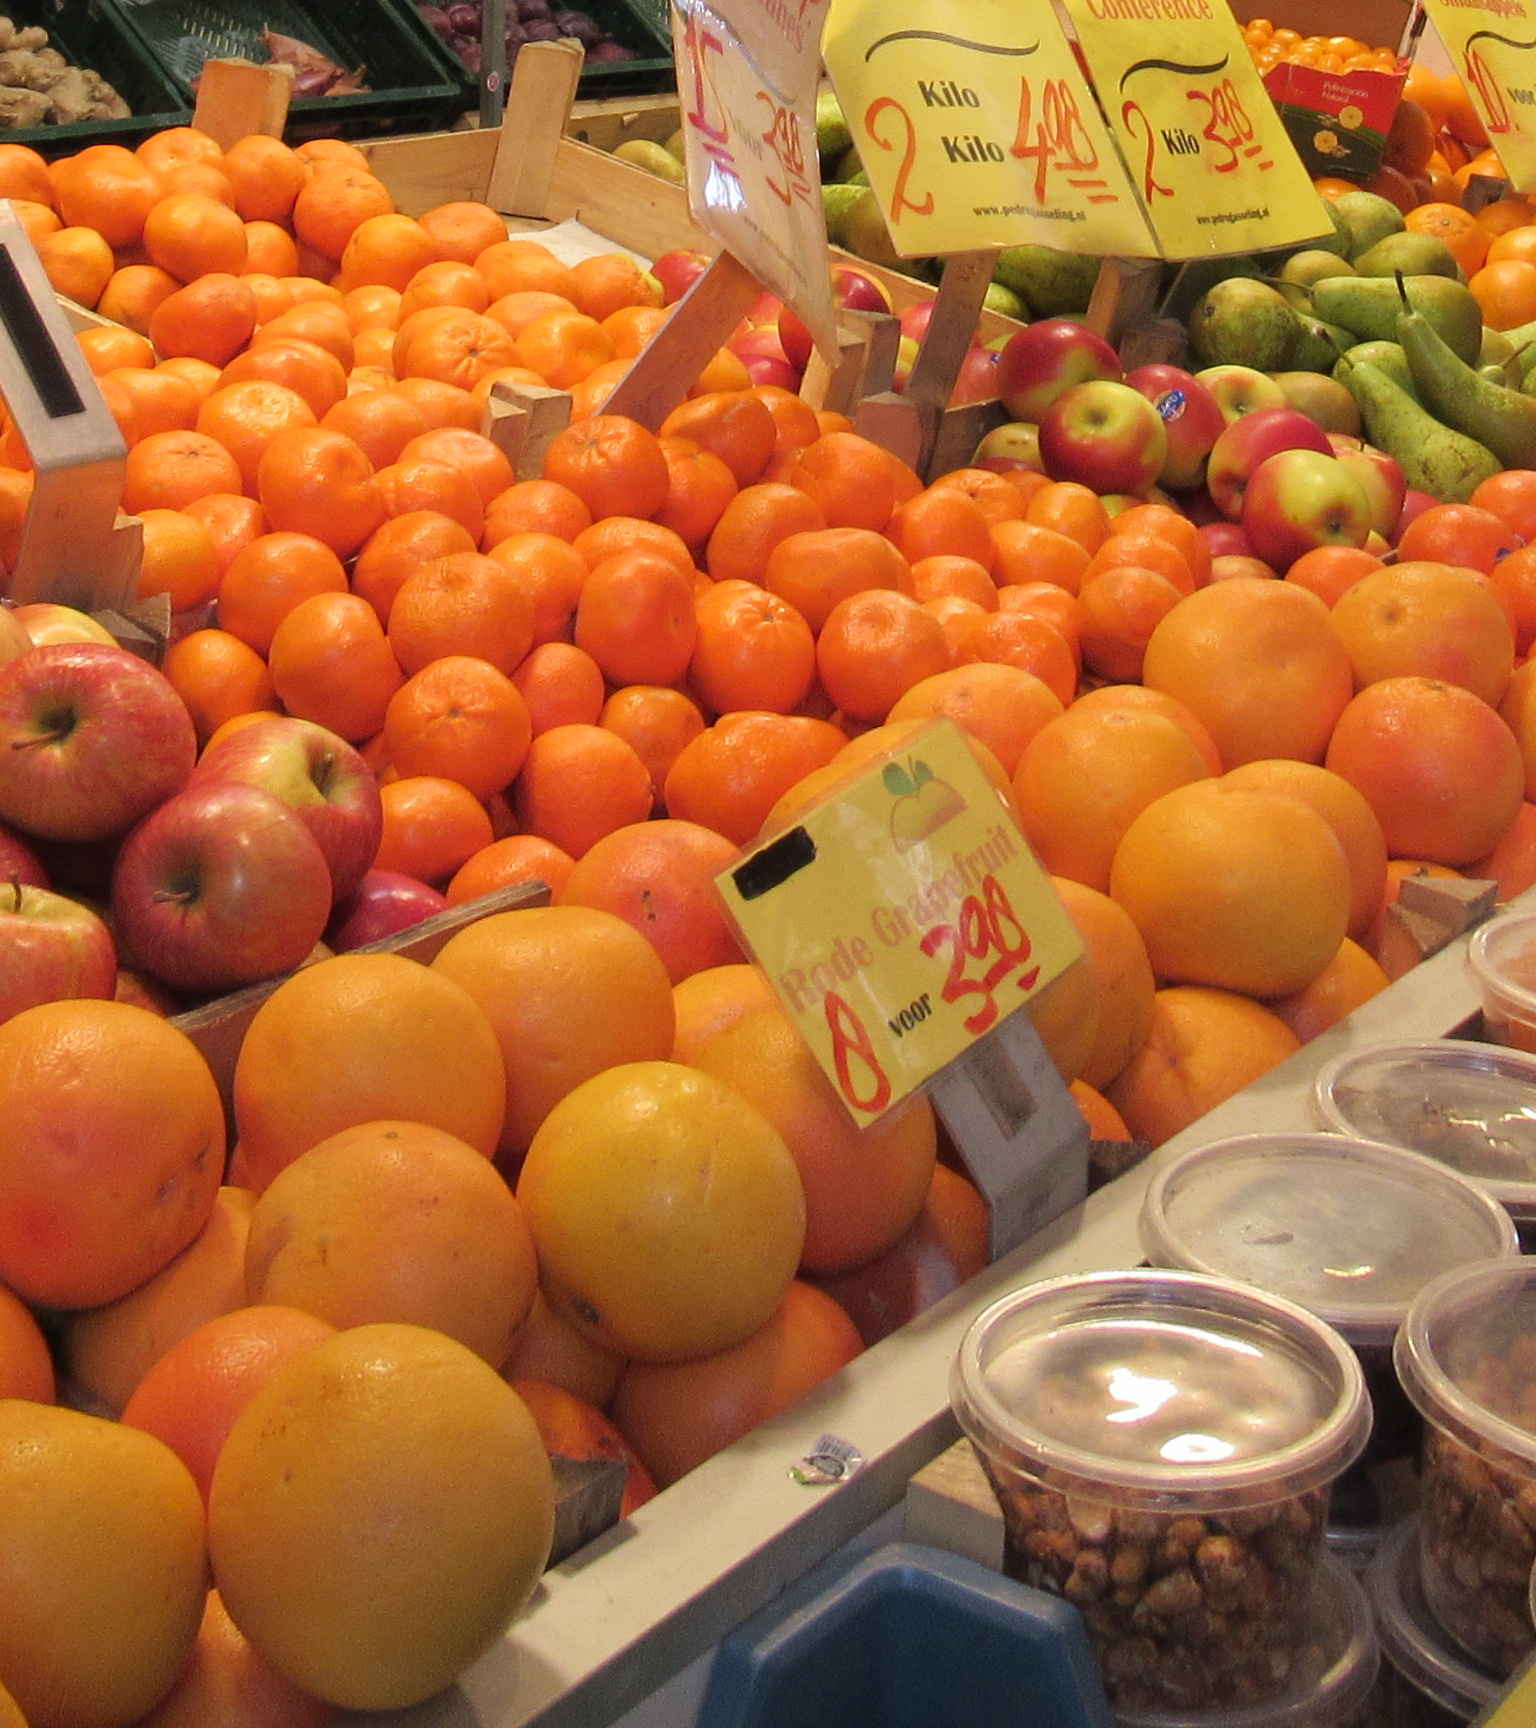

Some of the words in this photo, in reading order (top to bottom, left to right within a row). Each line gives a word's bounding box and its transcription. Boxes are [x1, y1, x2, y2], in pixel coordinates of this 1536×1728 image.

[918, 79, 980, 108] Kilo
[1509, 87, 1536, 105] voor
[864, 96, 935, 225] 2
[942, 134, 1005, 163] Kilo
[1122, 99, 1175, 206] 2
[1163, 128, 1201, 156] Kilo
[779, 930, 876, 1016] Rode
[871, 822, 1020, 950] Grapefruit
[888, 991, 934, 1039] voor
